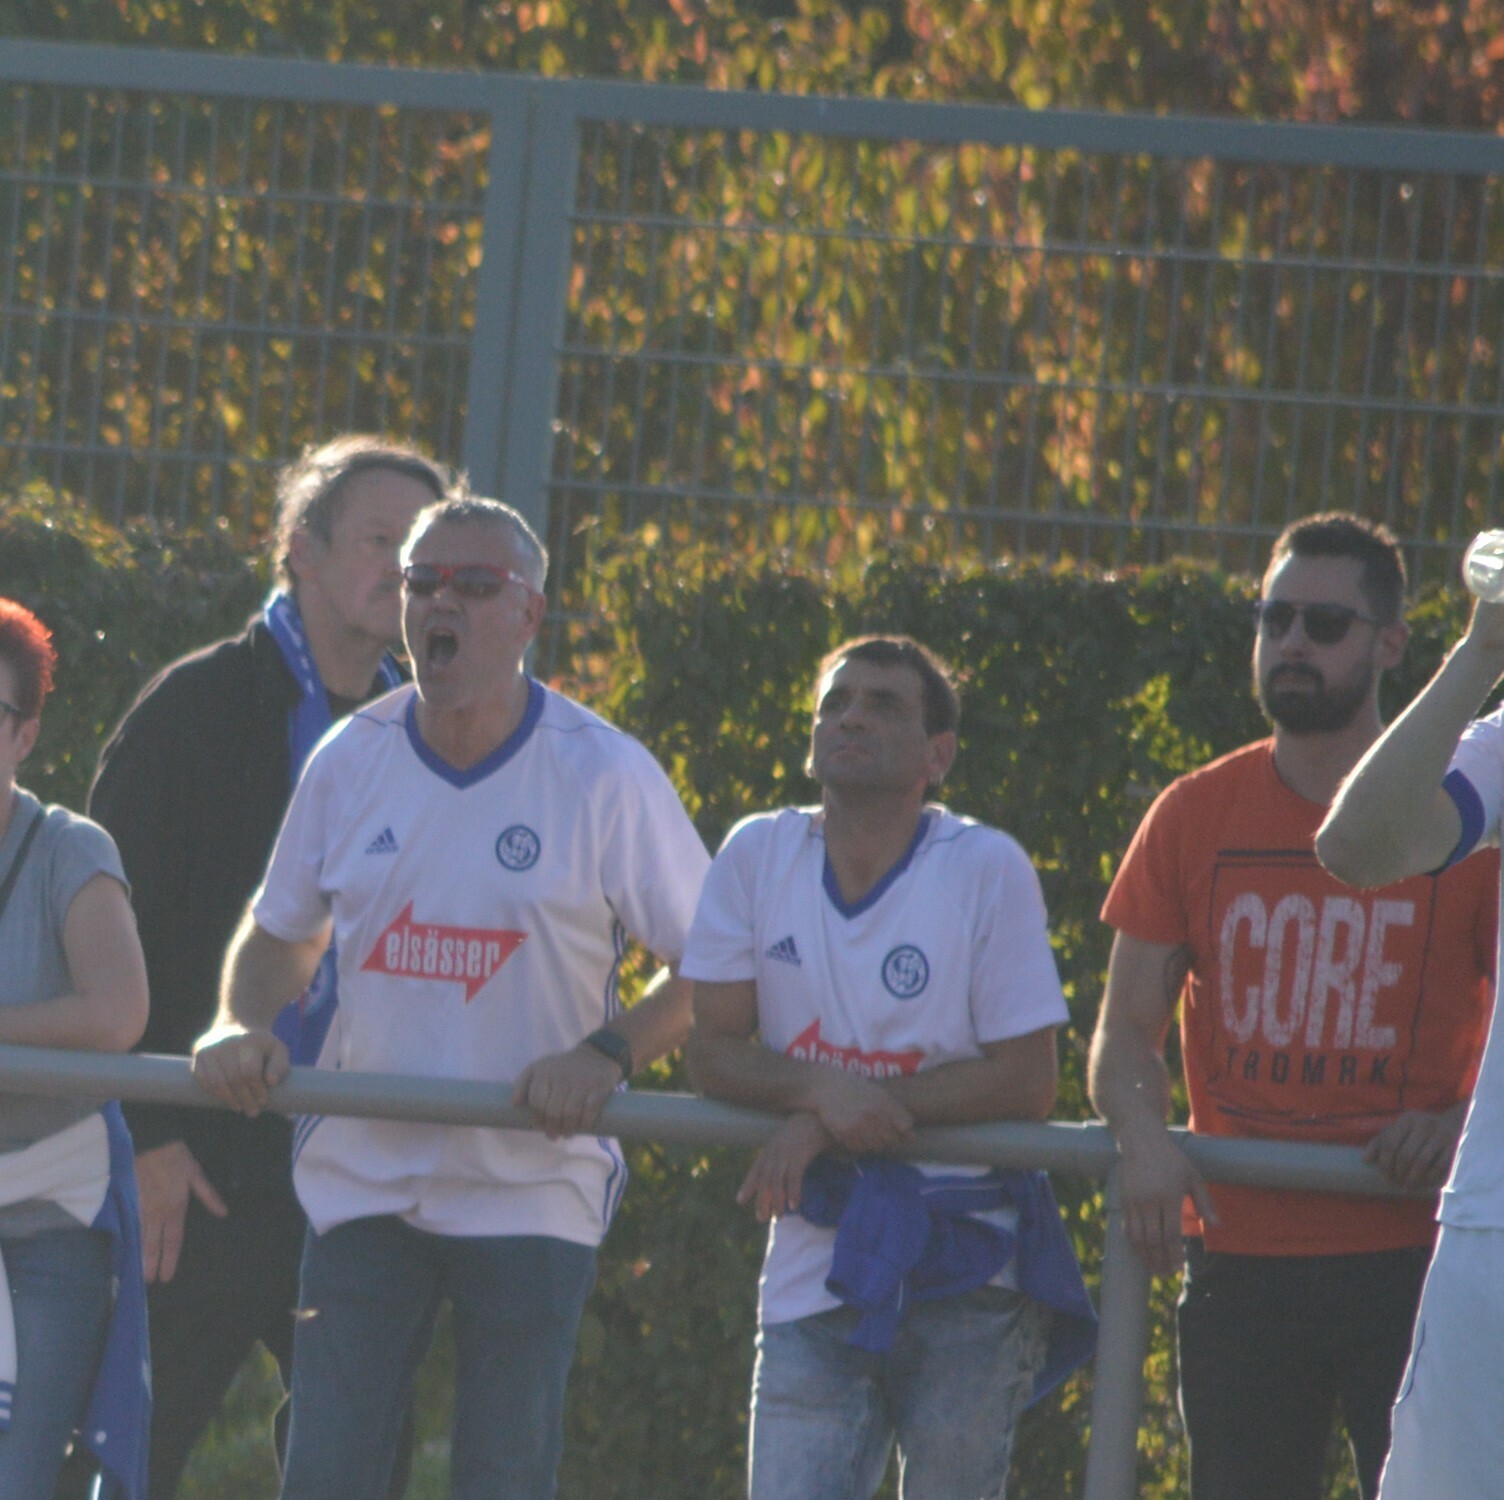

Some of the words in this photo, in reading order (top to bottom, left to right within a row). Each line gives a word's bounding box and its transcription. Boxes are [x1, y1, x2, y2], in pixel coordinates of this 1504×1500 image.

[385, 925, 500, 977] elsässer
[1220, 893, 1415, 1049] CORE
[1227, 1046, 1391, 1085] TRDMRK
